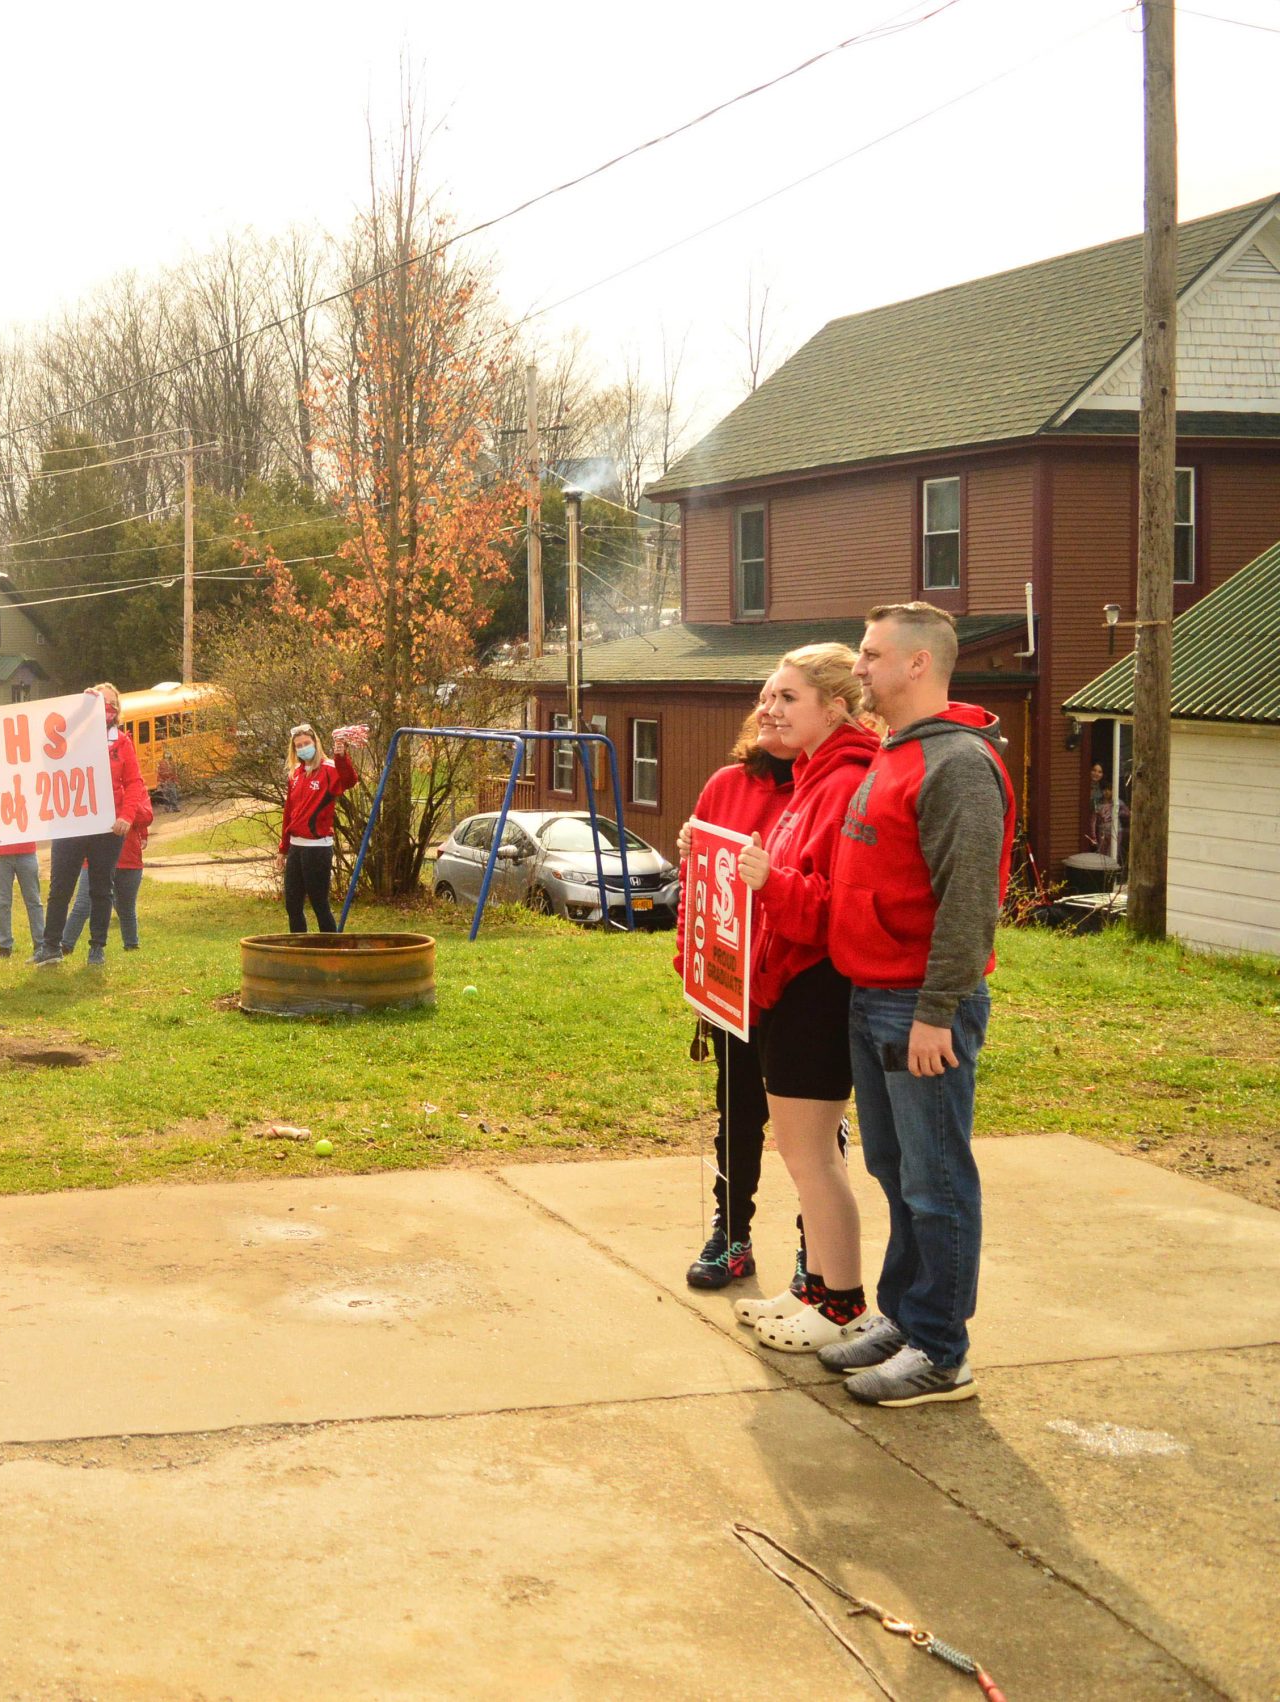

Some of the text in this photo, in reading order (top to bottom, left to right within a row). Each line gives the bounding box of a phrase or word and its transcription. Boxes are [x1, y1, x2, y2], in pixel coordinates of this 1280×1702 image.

[0, 774, 28, 833] of
[35, 766, 98, 821] 2021
[693, 847, 709, 988] 2021
